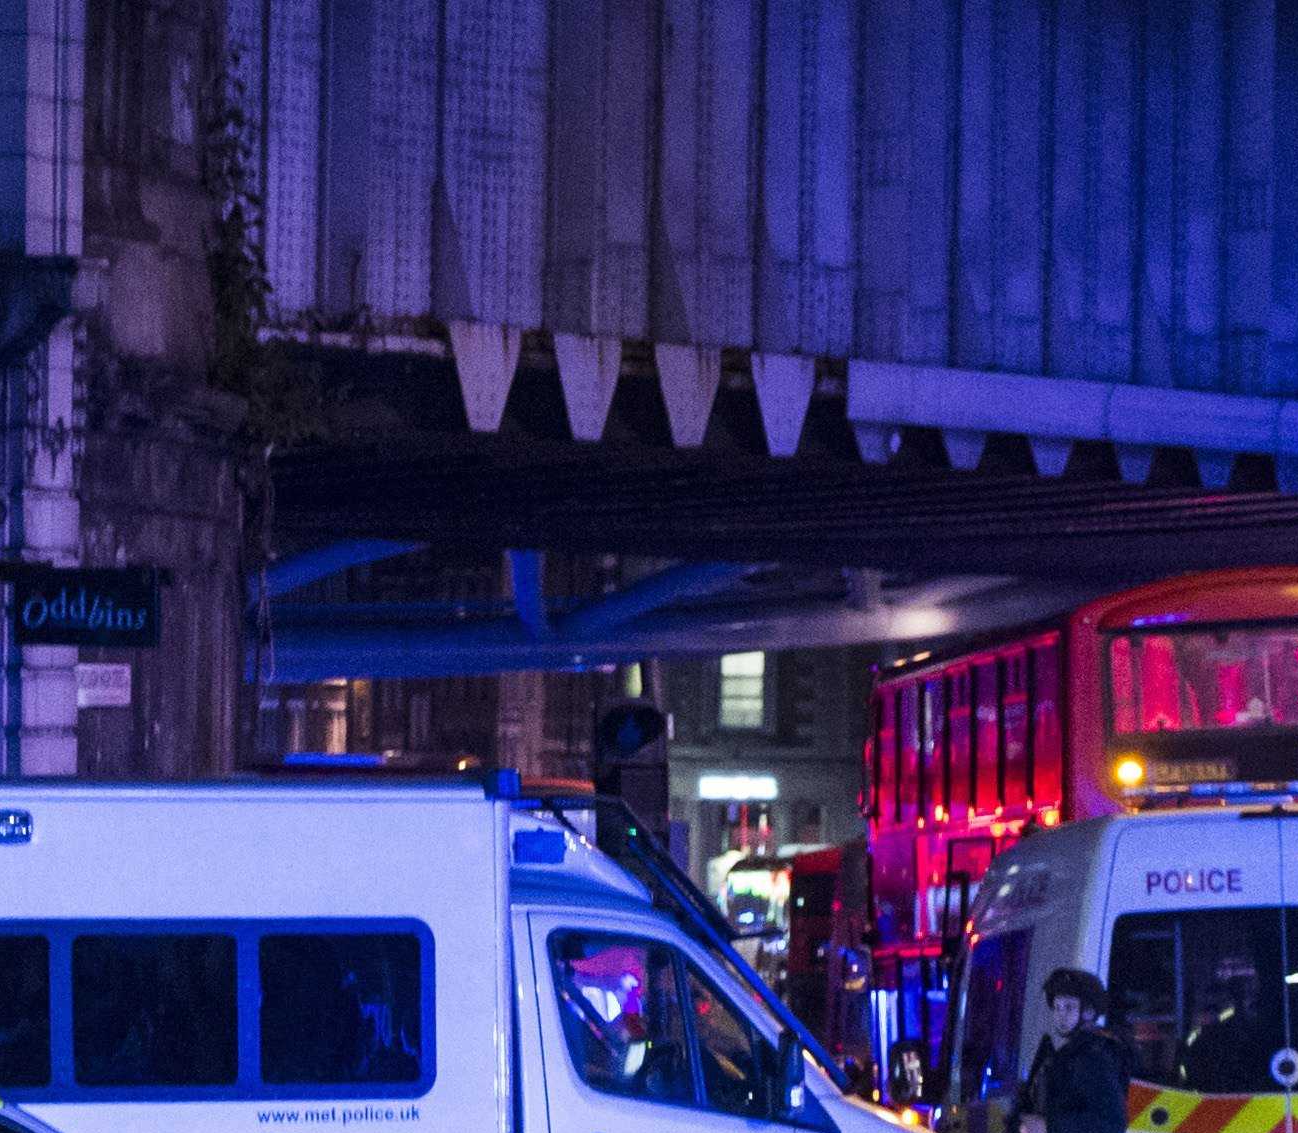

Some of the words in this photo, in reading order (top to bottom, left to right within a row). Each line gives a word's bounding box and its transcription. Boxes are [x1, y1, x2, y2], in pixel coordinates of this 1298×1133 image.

[21, 585, 149, 631] Oddbins
[1144, 869, 1243, 895] POLICE
[256, 1103, 422, 1126] www.met.police.uk
